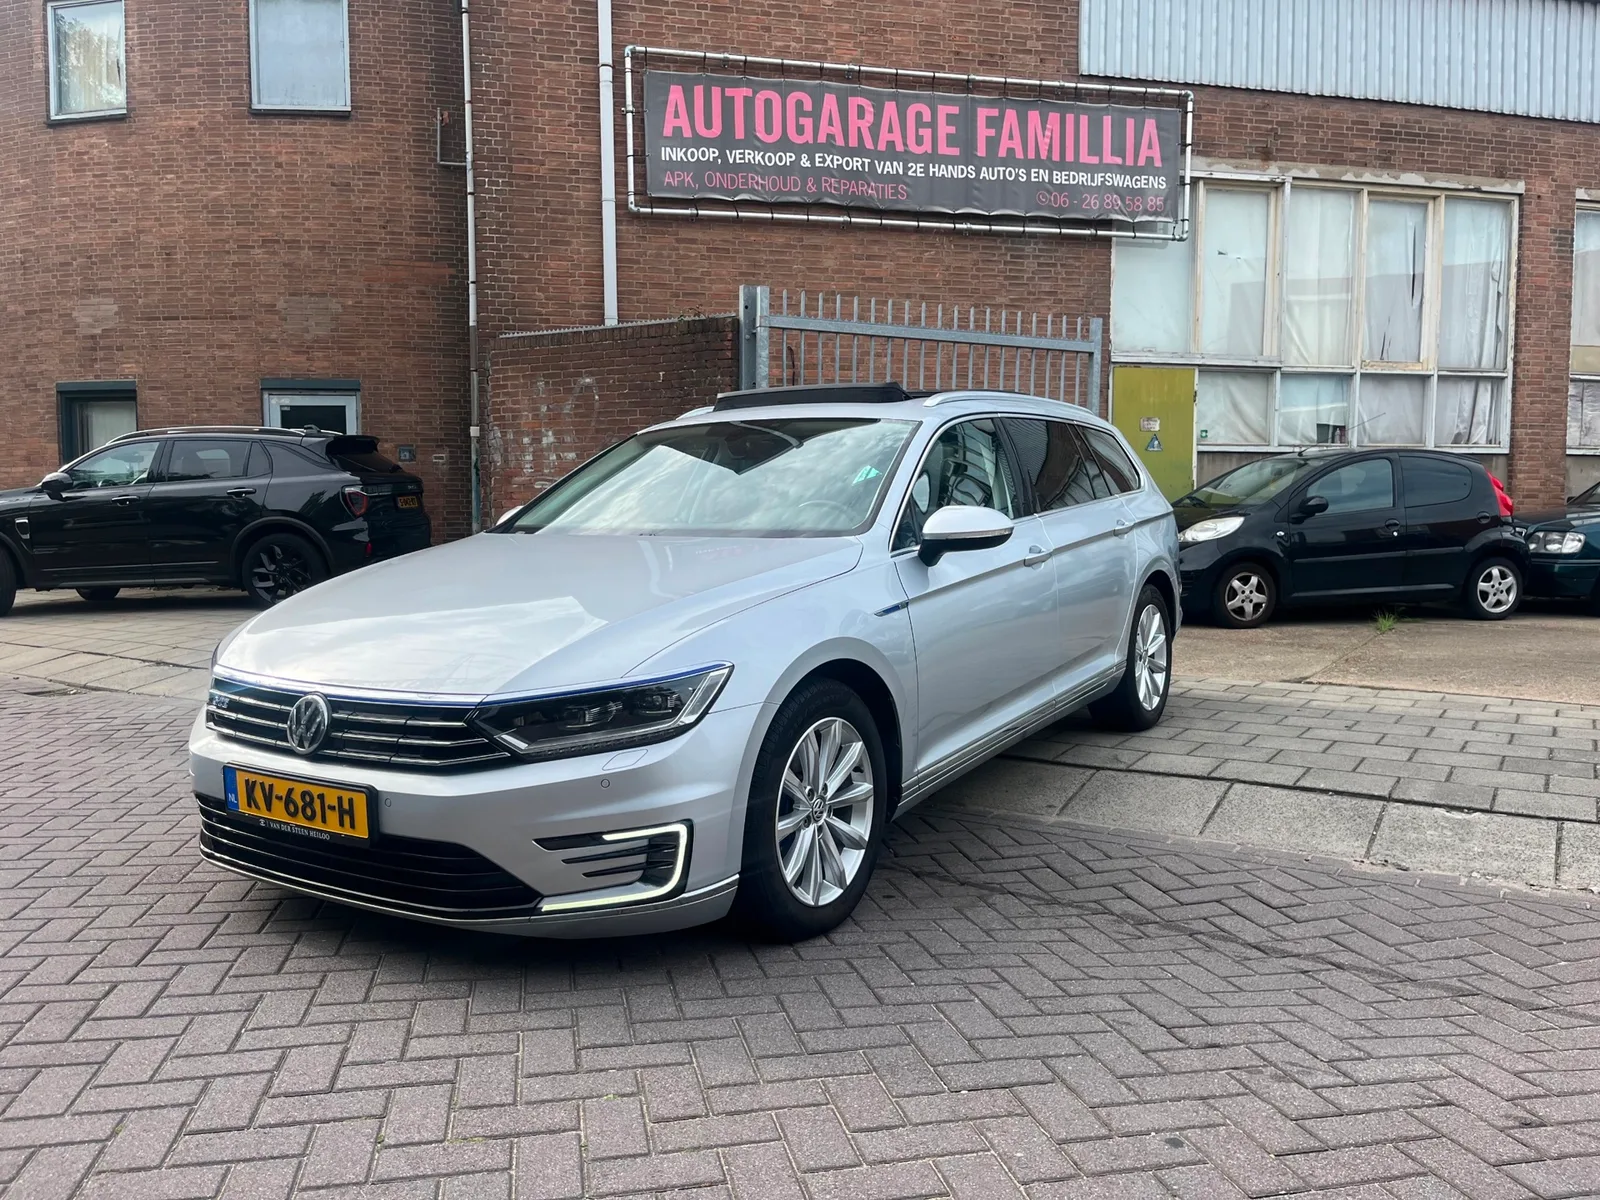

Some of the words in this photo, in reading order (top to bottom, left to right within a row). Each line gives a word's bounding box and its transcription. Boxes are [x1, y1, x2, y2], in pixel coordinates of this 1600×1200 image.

[662, 84, 960, 156] AUTOGARAGE
[976, 107, 1163, 168] FAMILLIA
[661, 146, 722, 165] INKOOP,
[726, 149, 796, 167] VERKOOP
[800, 153, 811, 168] &
[815, 153, 871, 172] EXPORT
[874, 160, 904, 175] VAN
[907, 163, 925, 177] 2E
[929, 163, 976, 179] HANDS
[979, 166, 1027, 182] AUTO'S
[1030, 168, 1049, 183] EN
[1052, 170, 1167, 189] BEDRIJFSWAGENS
[663, 170, 699, 190] APK,
[704, 170, 801, 192] ONDERHOUD
[806, 176, 817, 193] &
[821, 176, 907, 200] REPARATIES
[1051, 192, 1069, 208] 06
[1082, 193, 1099, 210] 26
[1103, 193, 1121, 210] 89
[1125, 196, 1143, 212] 58
[1147, 196, 1164, 212] 85
[228, 794, 238, 804] NL
[244, 777, 356, 830] KV-681-H
[269, 821, 280, 830] VAN
[281, 824, 291, 833] DER
[291, 827, 309, 836] STEEN
